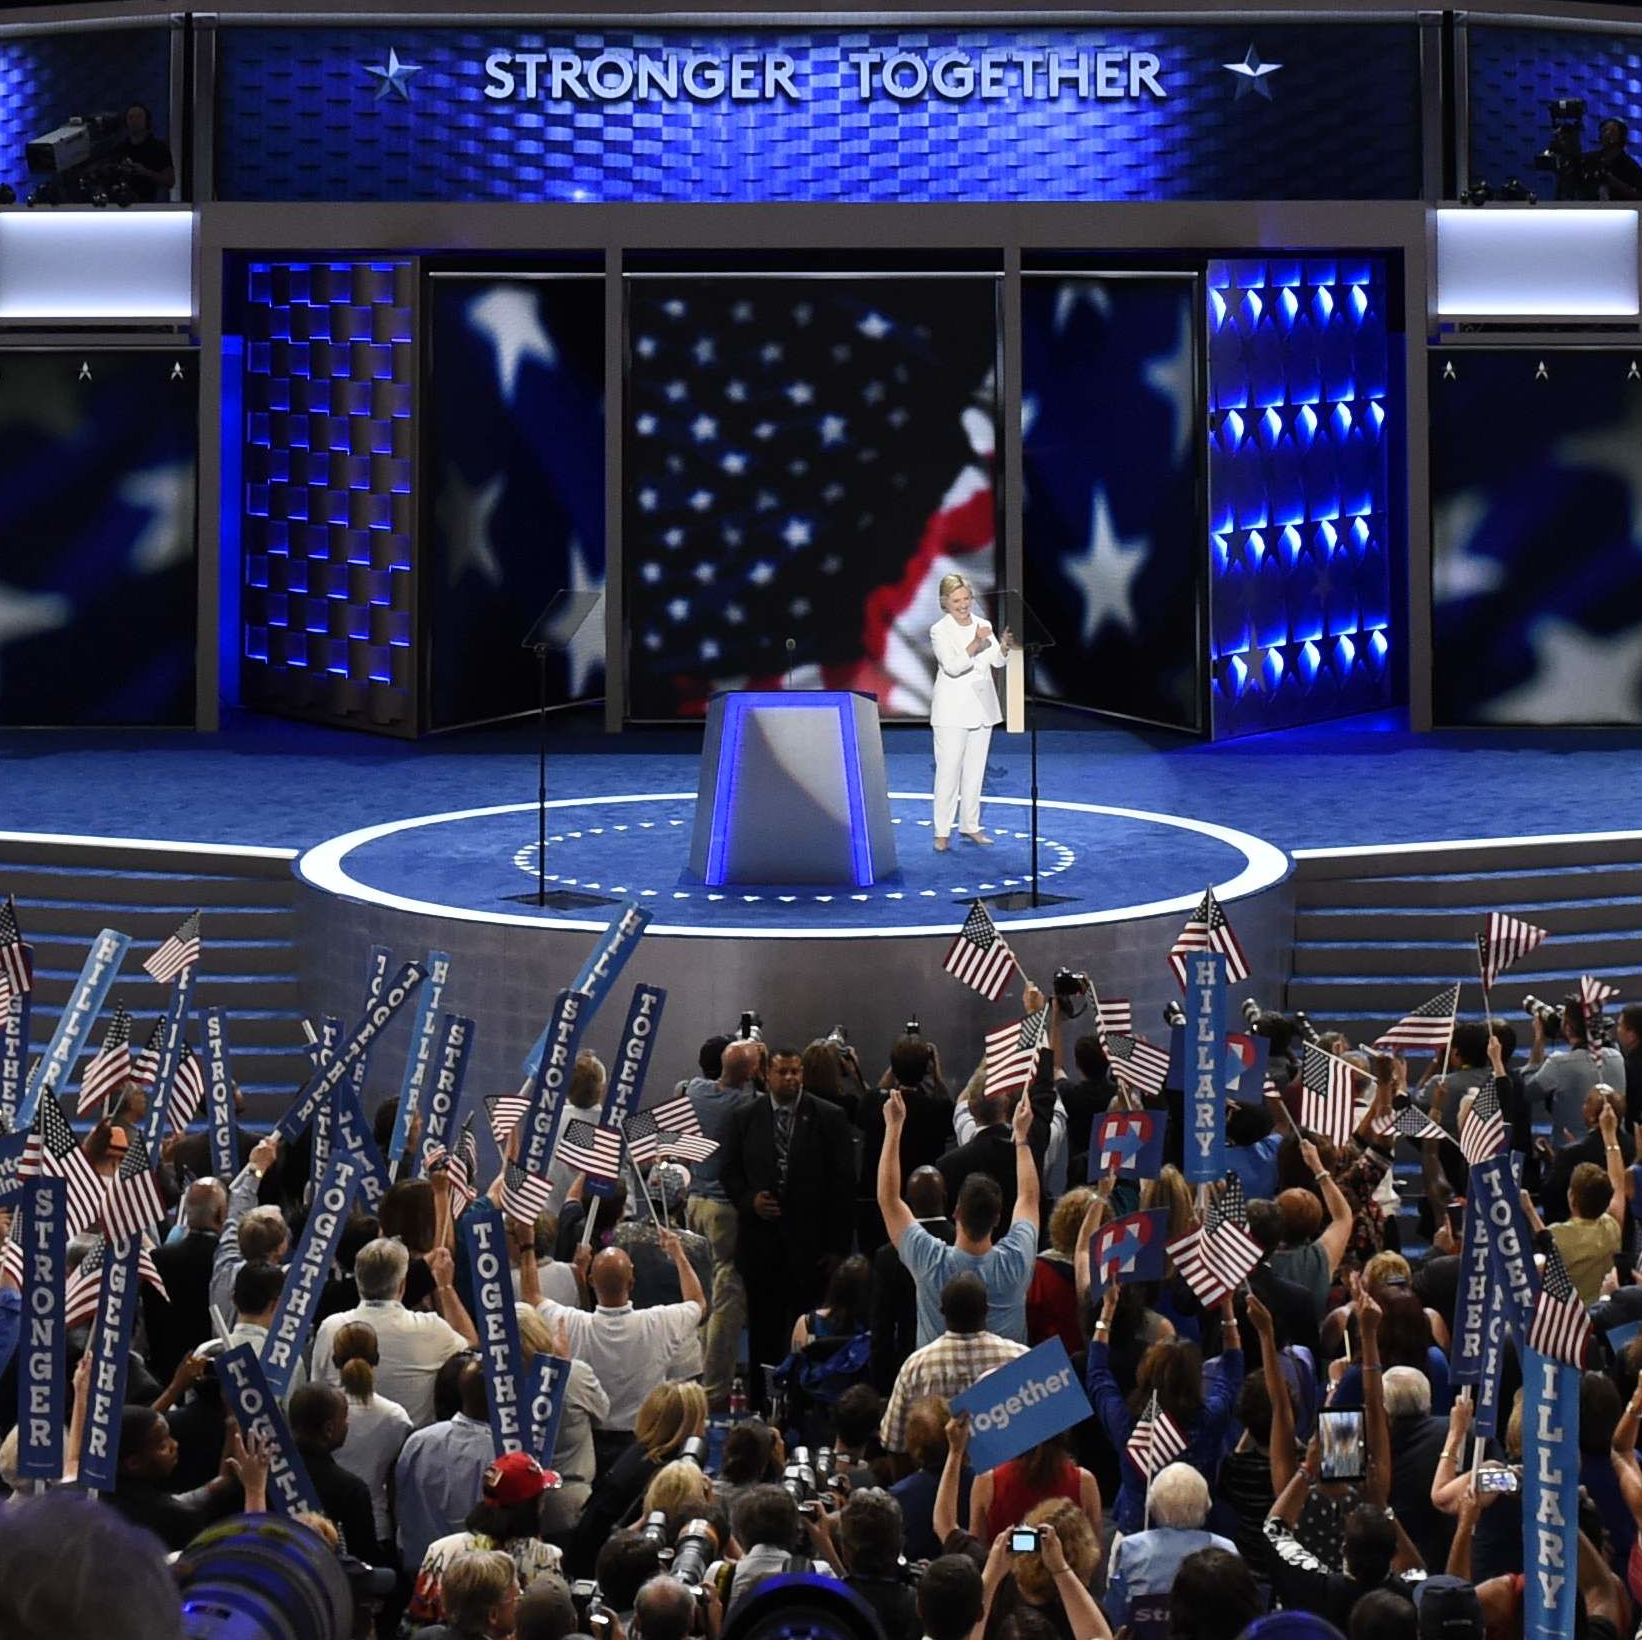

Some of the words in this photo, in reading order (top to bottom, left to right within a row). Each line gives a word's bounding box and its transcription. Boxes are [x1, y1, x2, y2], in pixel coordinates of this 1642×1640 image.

[483, 52, 801, 100] STRONGER
[847, 52, 1166, 100] TOGETHER
[401, 961, 449, 1137] HILLARY
[1195, 960, 1216, 1157] HILLARY
[30, 1189, 56, 1447] STRONGER
[269, 1161, 355, 1368] TOGETHER
